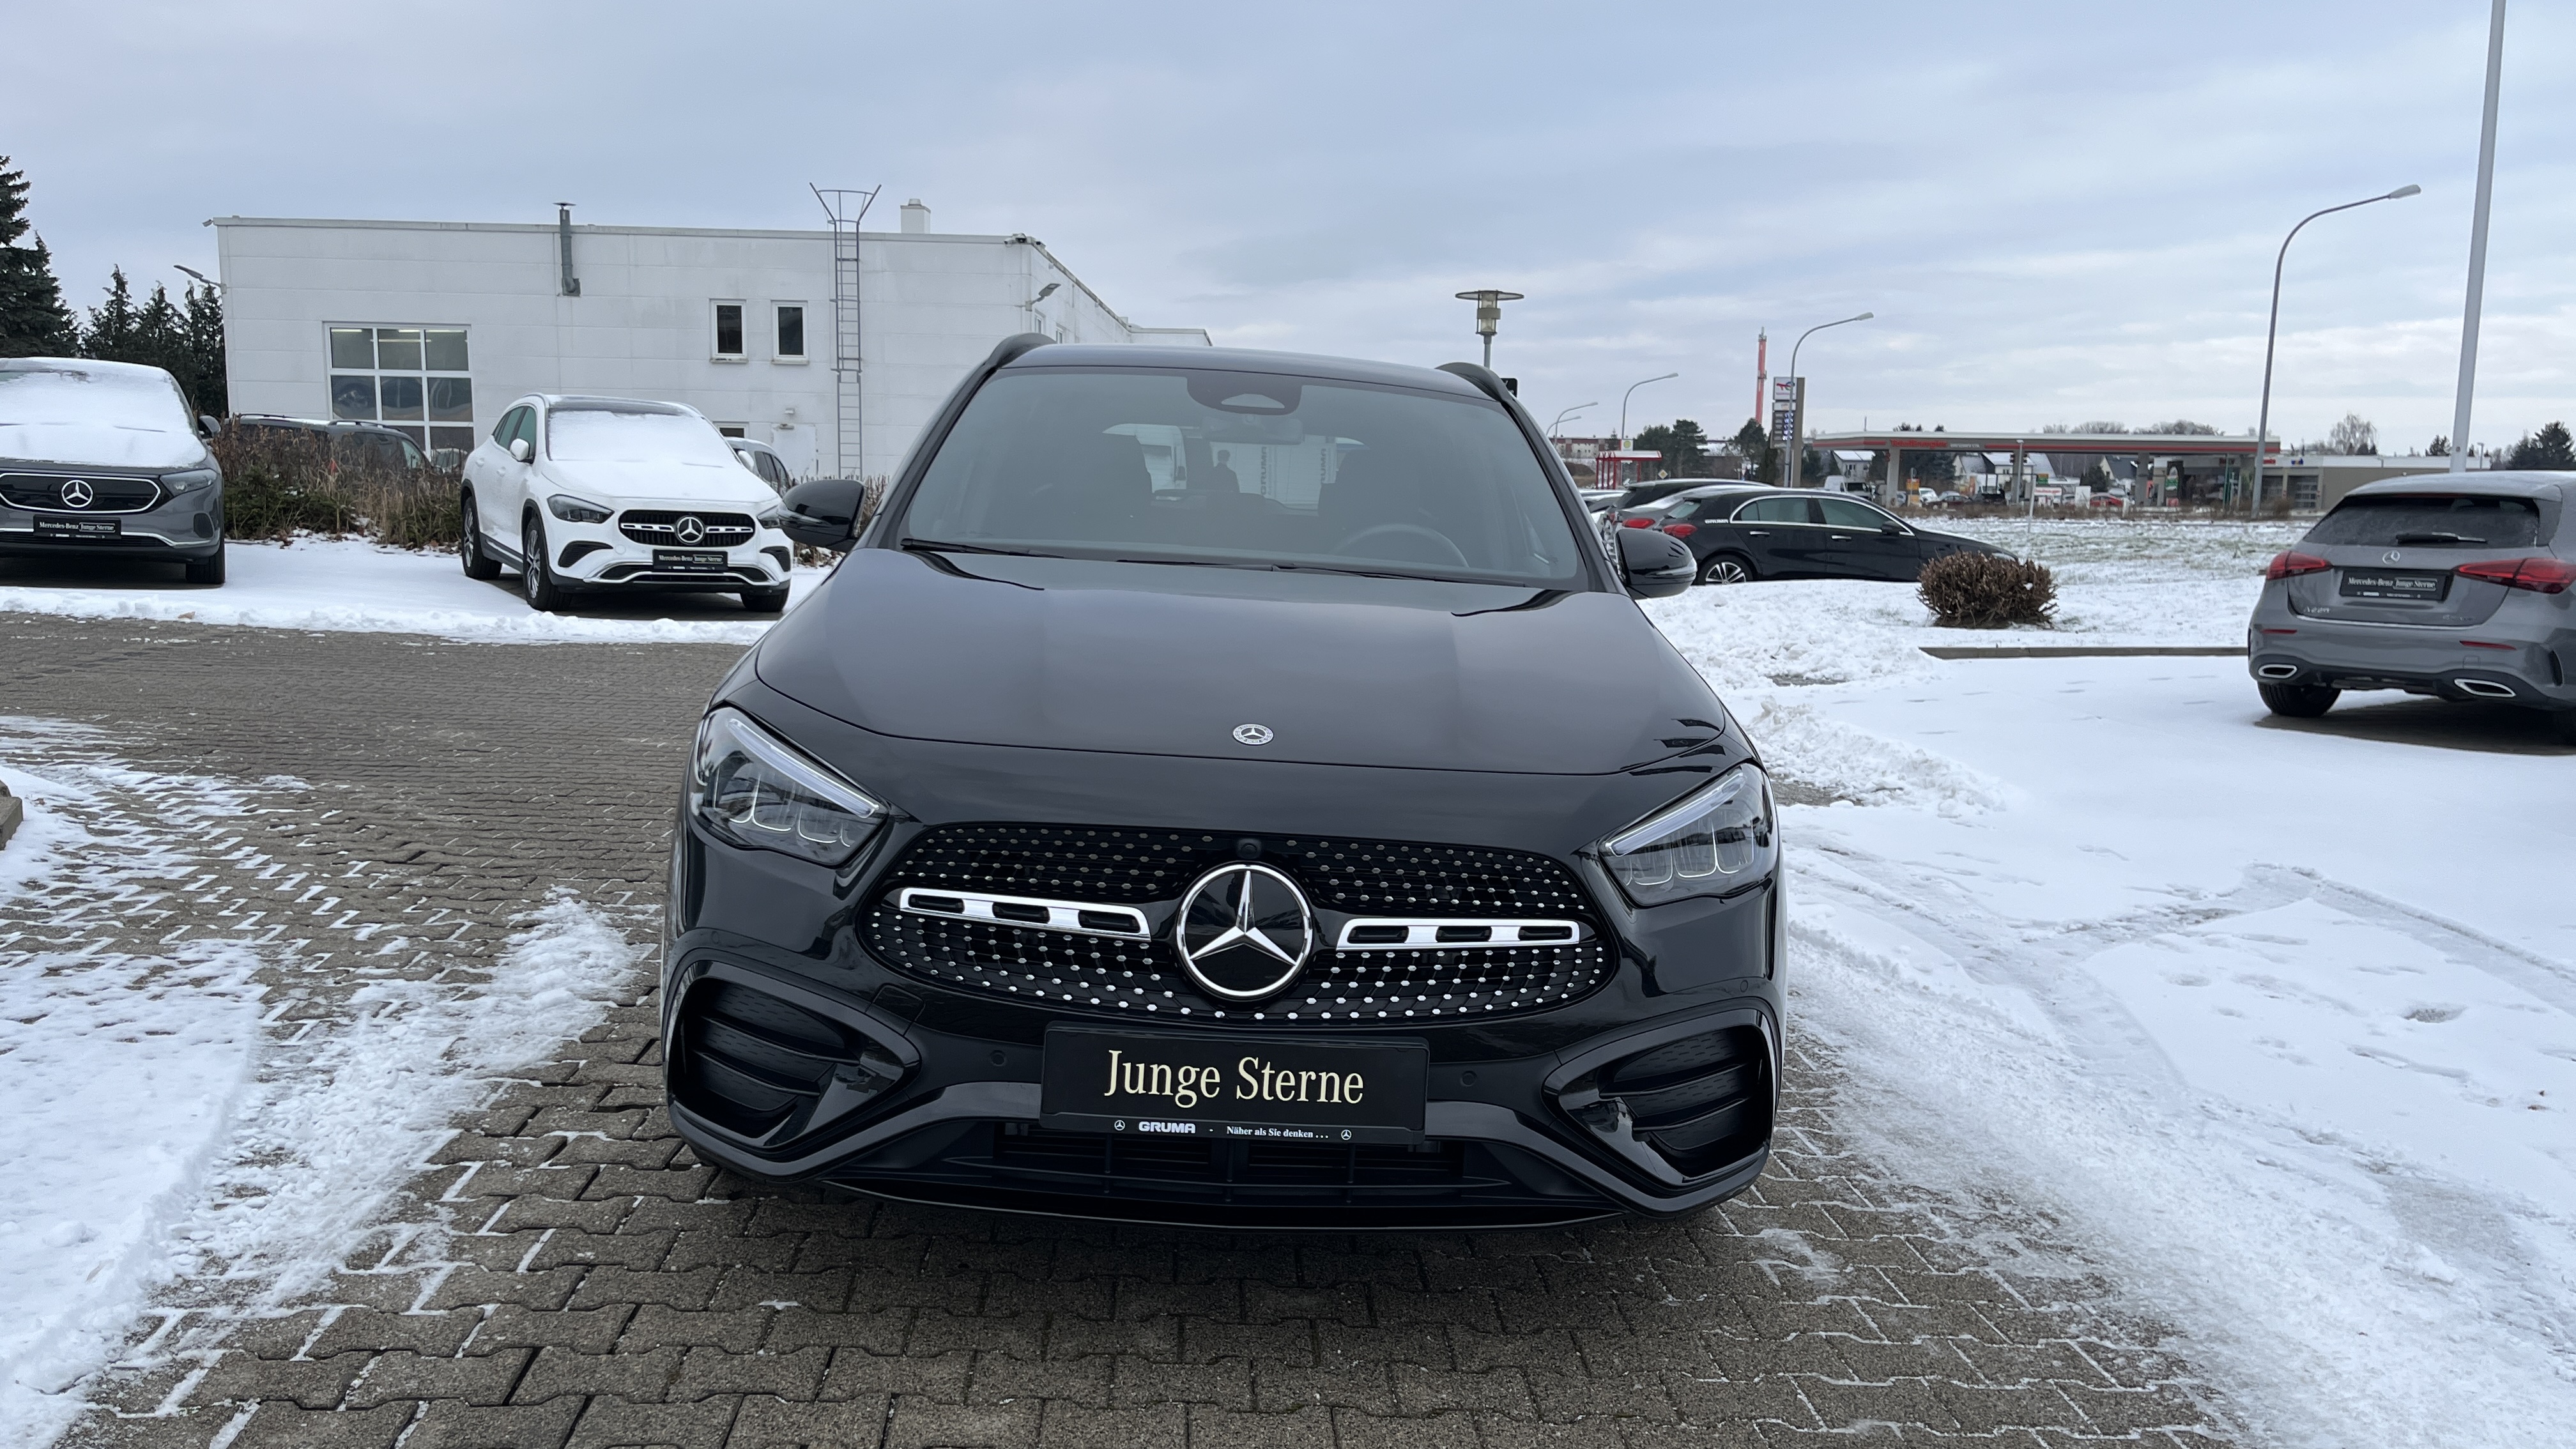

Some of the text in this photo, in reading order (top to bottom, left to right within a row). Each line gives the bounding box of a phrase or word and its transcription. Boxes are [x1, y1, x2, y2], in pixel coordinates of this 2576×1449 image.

[1104, 1050, 1363, 1108] Junge Sterne
[1138, 1121, 1196, 1134] GRUMA
[1226, 1126, 1253, 1135] Näher
[1254, 1127, 1266, 1136] als
[1268, 1128, 1282, 1137] Sie
[1283, 1128, 1314, 1138] denken
